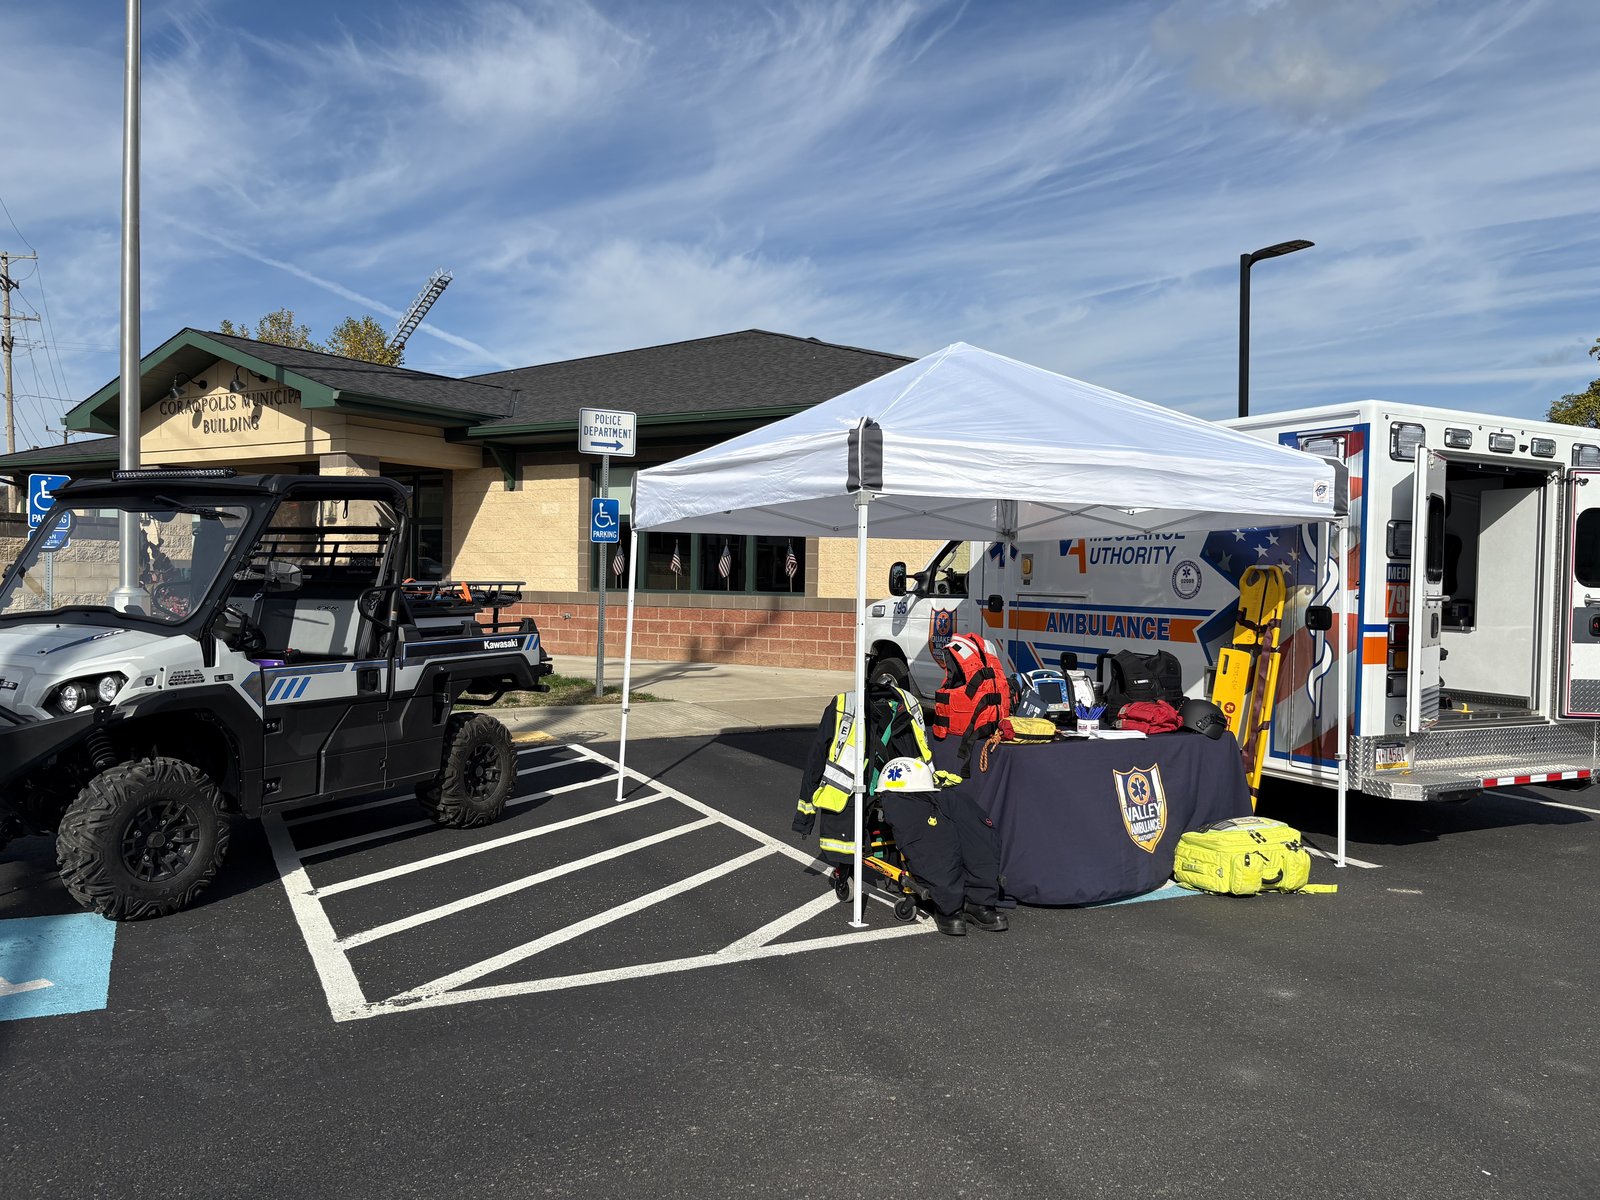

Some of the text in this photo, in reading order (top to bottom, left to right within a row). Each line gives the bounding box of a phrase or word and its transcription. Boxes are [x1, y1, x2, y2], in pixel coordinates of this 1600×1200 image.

[160, 394, 237, 416] CORAOPOLIS
[203, 415, 260, 434] BUILDING
[594, 413, 622, 426] POLICE
[583, 425, 632, 439] DEPARTMENT
[592, 530, 617, 539] PARKING
[893, 602, 908, 614] 795
[1046, 612, 1170, 641] AMBULANCE
[483, 638, 518, 650] Kawasaki
[1124, 802, 1162, 822] VALLEY
[1131, 819, 1162, 835] AMBULANCE
